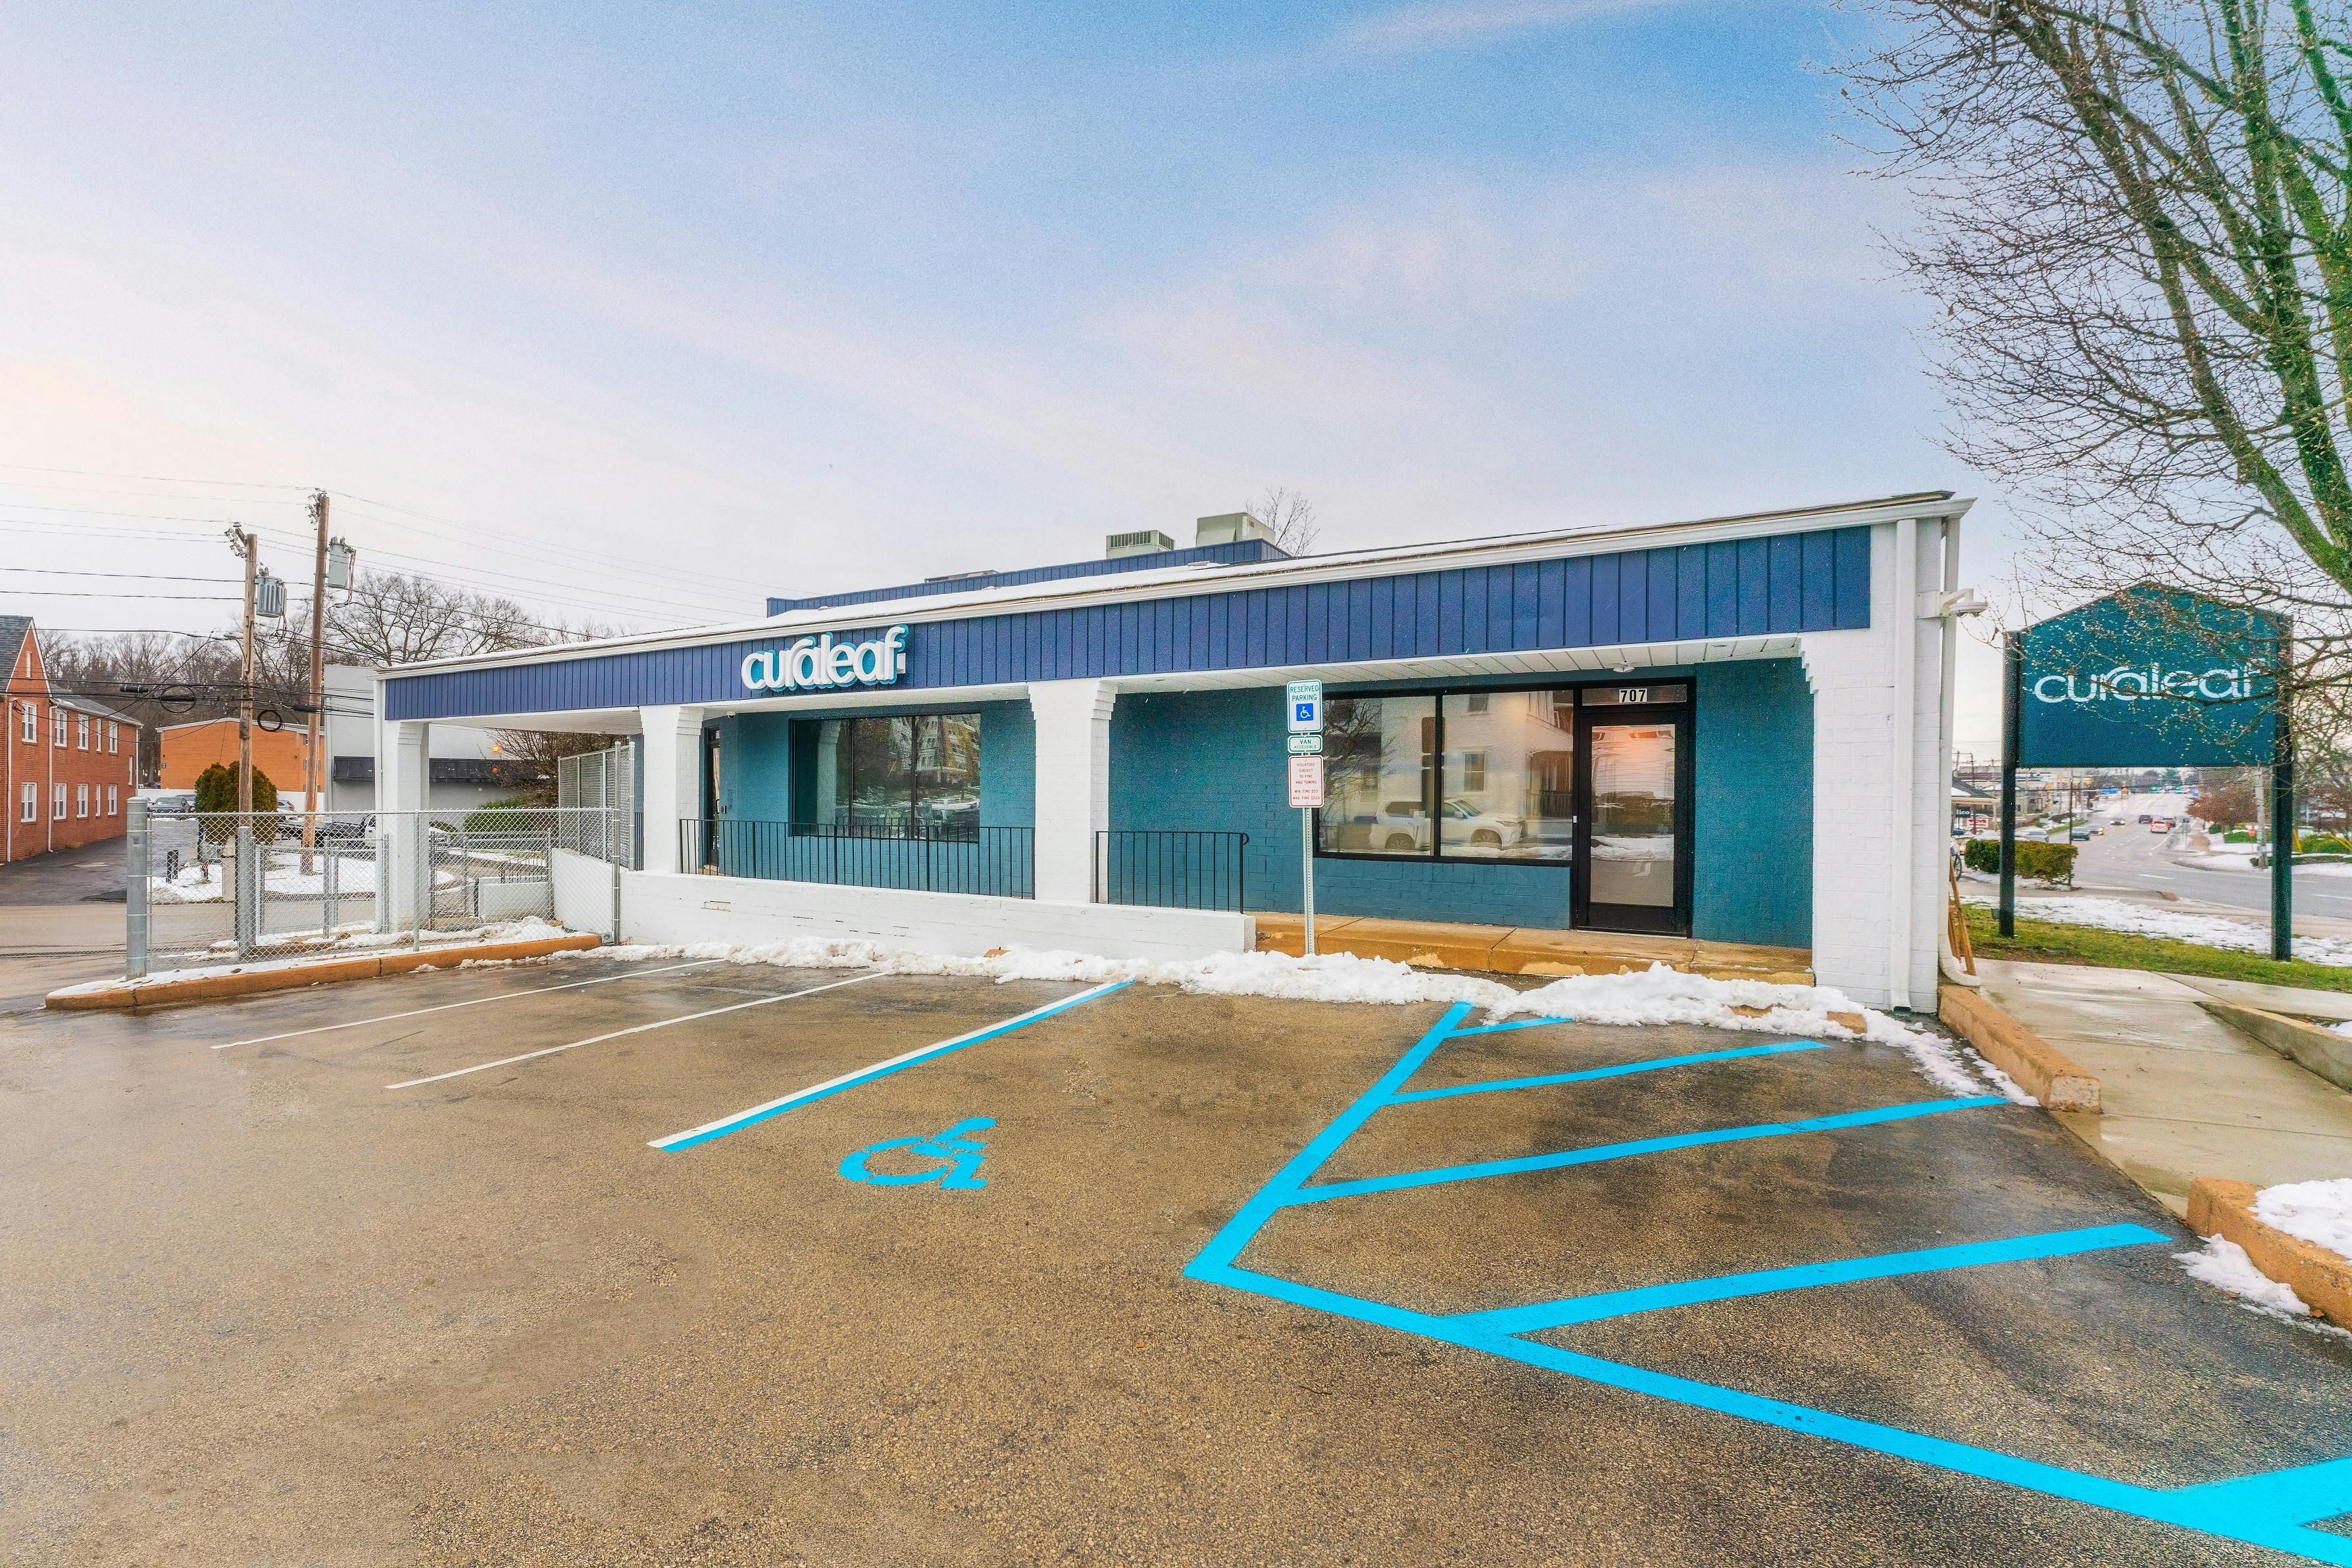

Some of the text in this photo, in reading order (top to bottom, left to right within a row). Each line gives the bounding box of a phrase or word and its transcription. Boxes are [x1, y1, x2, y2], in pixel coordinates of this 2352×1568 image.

[741, 625, 906, 690] curaleaf
[1290, 685, 1319, 693] RESERVED
[2034, 658, 2264, 703] curaleaf
[1620, 689, 1646, 702] 707
